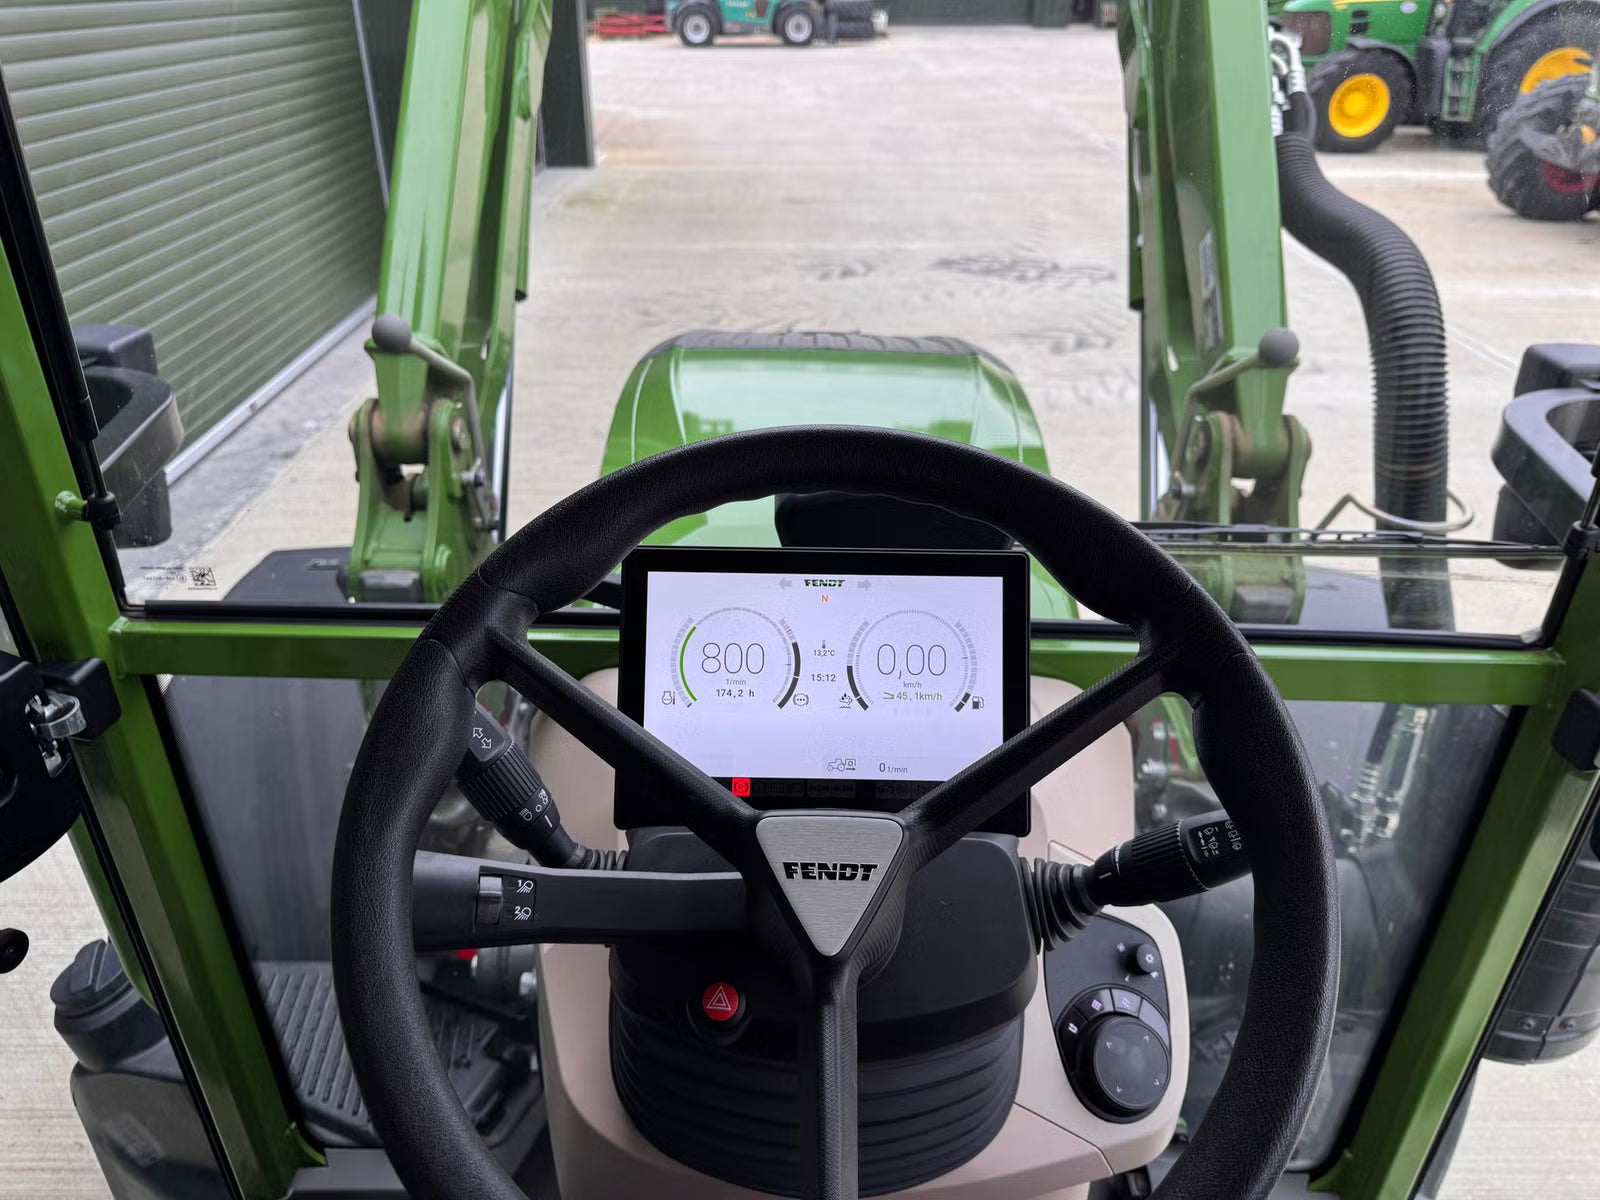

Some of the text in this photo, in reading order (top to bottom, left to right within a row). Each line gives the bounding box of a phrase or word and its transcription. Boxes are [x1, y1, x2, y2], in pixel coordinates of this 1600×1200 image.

[804, 579, 846, 587] FENDT
[821, 594, 829, 603] N
[701, 642, 765, 675] 800
[877, 643, 947, 680] 0,00
[726, 678, 747, 686] 1/min
[811, 673, 836, 683] 15:12
[903, 681, 922, 689] km/h
[716, 688, 755, 698] 174,2 h
[879, 762, 908, 774] 0 1/min
[782, 861, 878, 882] FENDT
